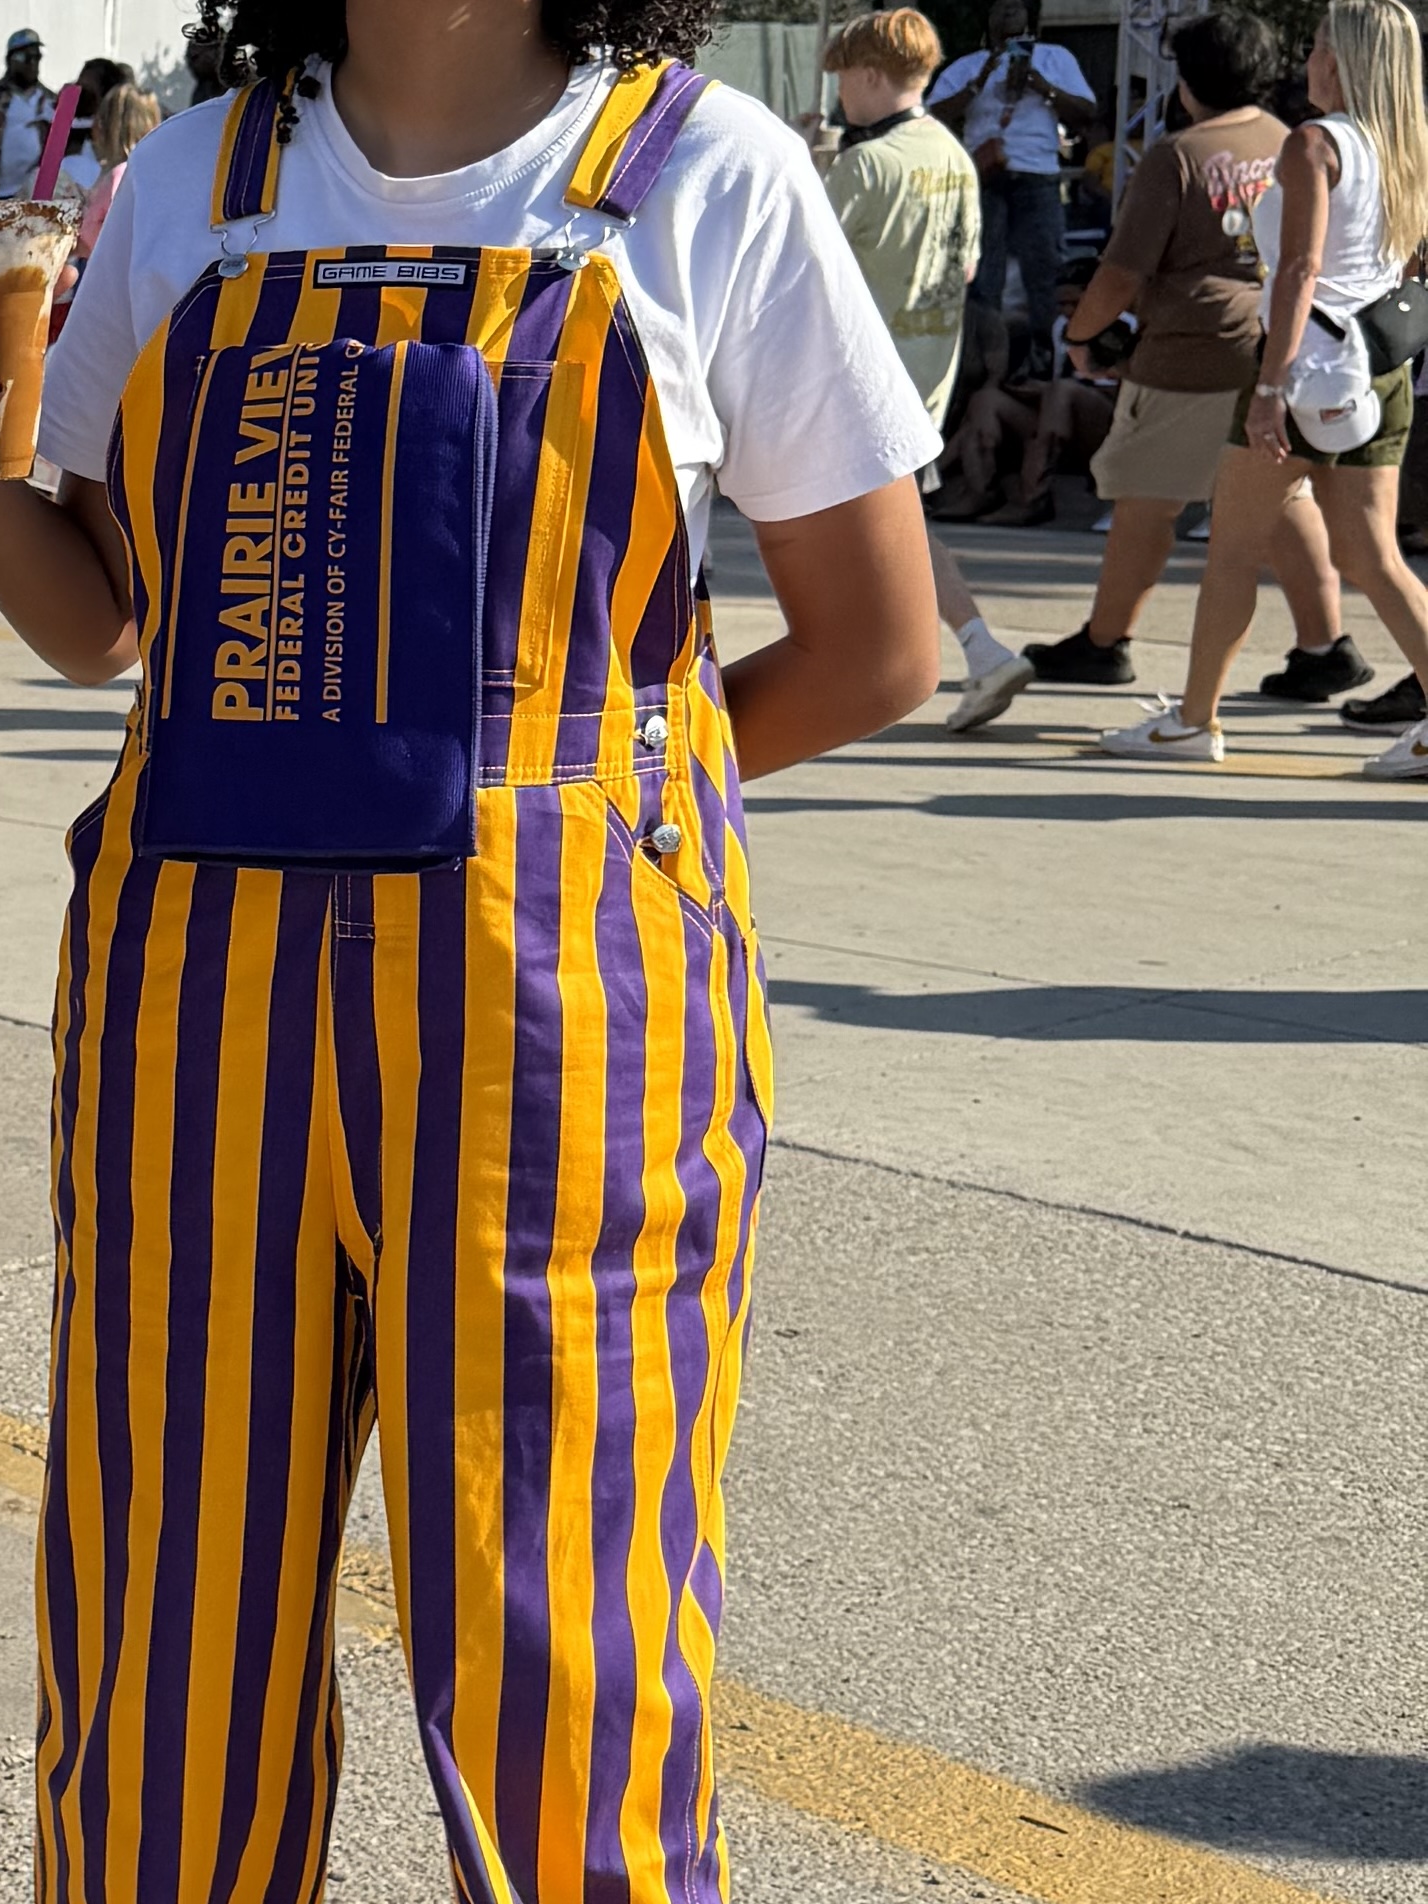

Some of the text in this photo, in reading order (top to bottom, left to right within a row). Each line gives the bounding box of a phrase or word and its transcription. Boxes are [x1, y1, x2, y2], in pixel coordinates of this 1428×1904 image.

[322, 265, 461, 280] GAME BIBS
[331, 363, 359, 463] FEDERAL
[282, 430, 313, 559] CREDIT
[327, 469, 350, 558] CY-FAIR
[212, 482, 277, 722] PRAIRIE
[326, 563, 346, 595] OF
[275, 573, 305, 721] FEDERAL
[322, 601, 345, 700] DIVISION
[321, 708, 341, 723] A
